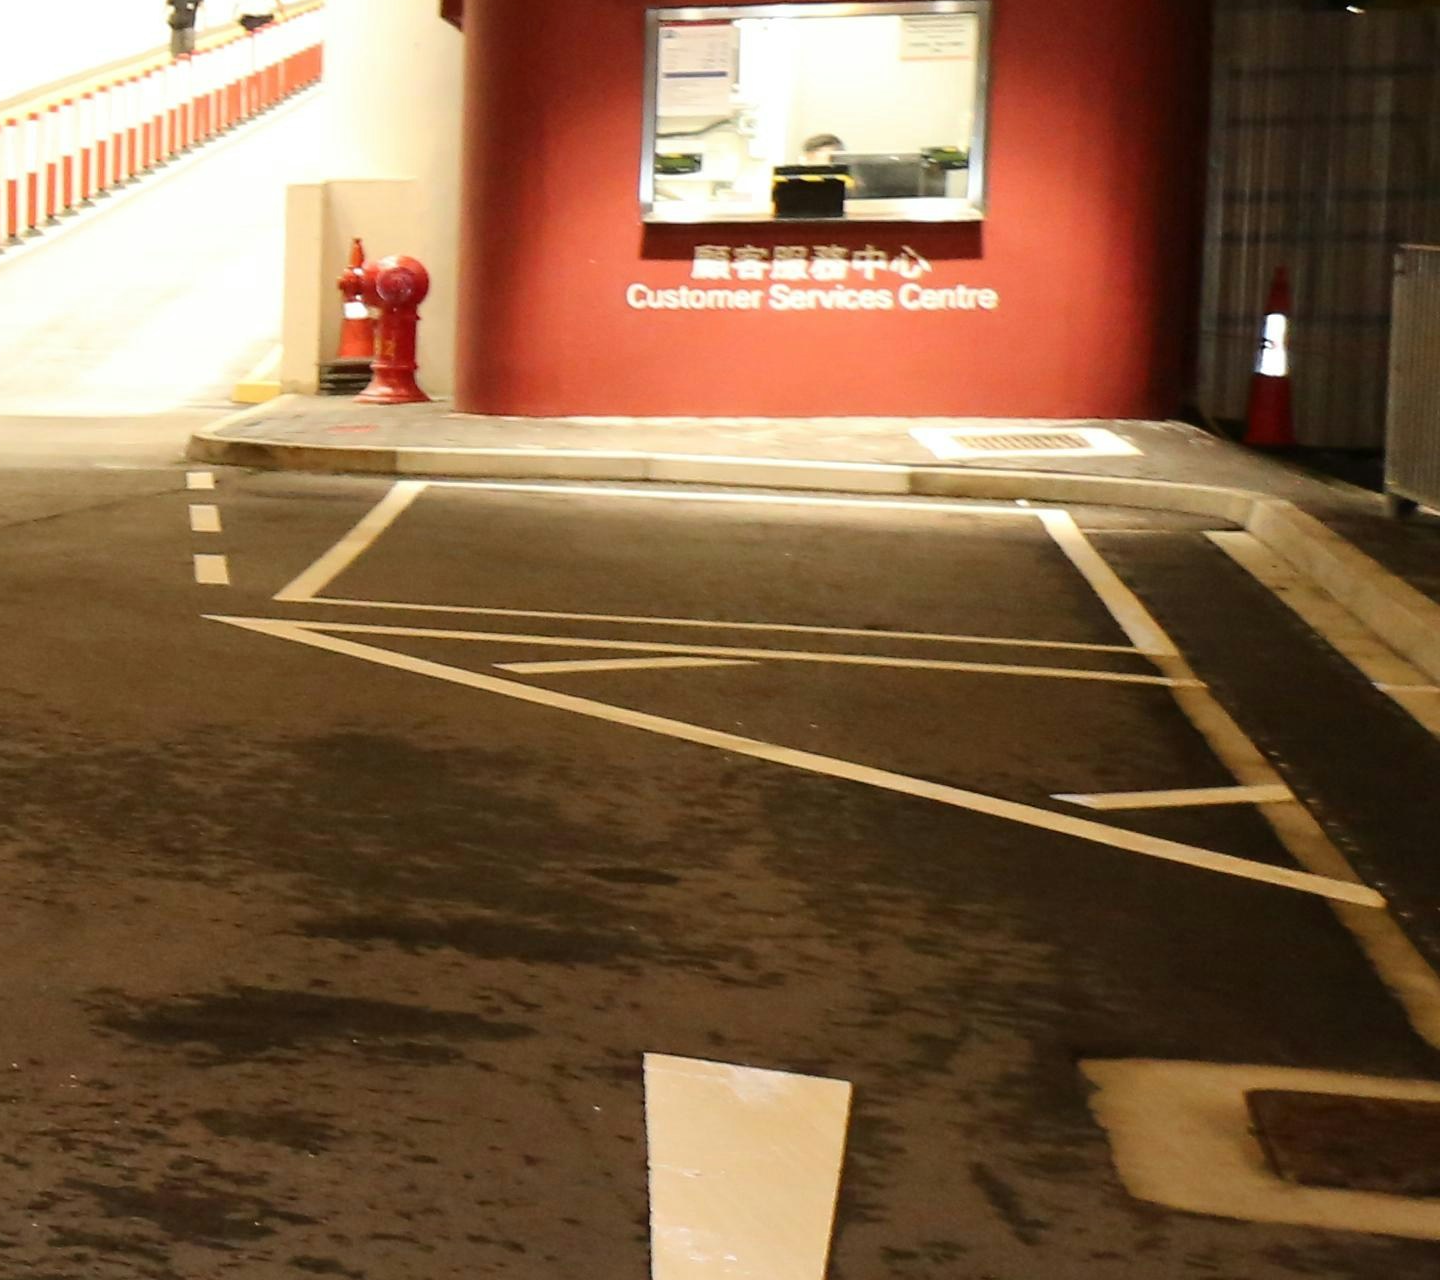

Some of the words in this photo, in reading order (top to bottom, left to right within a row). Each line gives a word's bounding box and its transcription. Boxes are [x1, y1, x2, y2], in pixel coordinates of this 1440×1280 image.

[626, 283, 764, 310] Customer
[768, 283, 895, 311] Services
[897, 282, 999, 311] Centre
